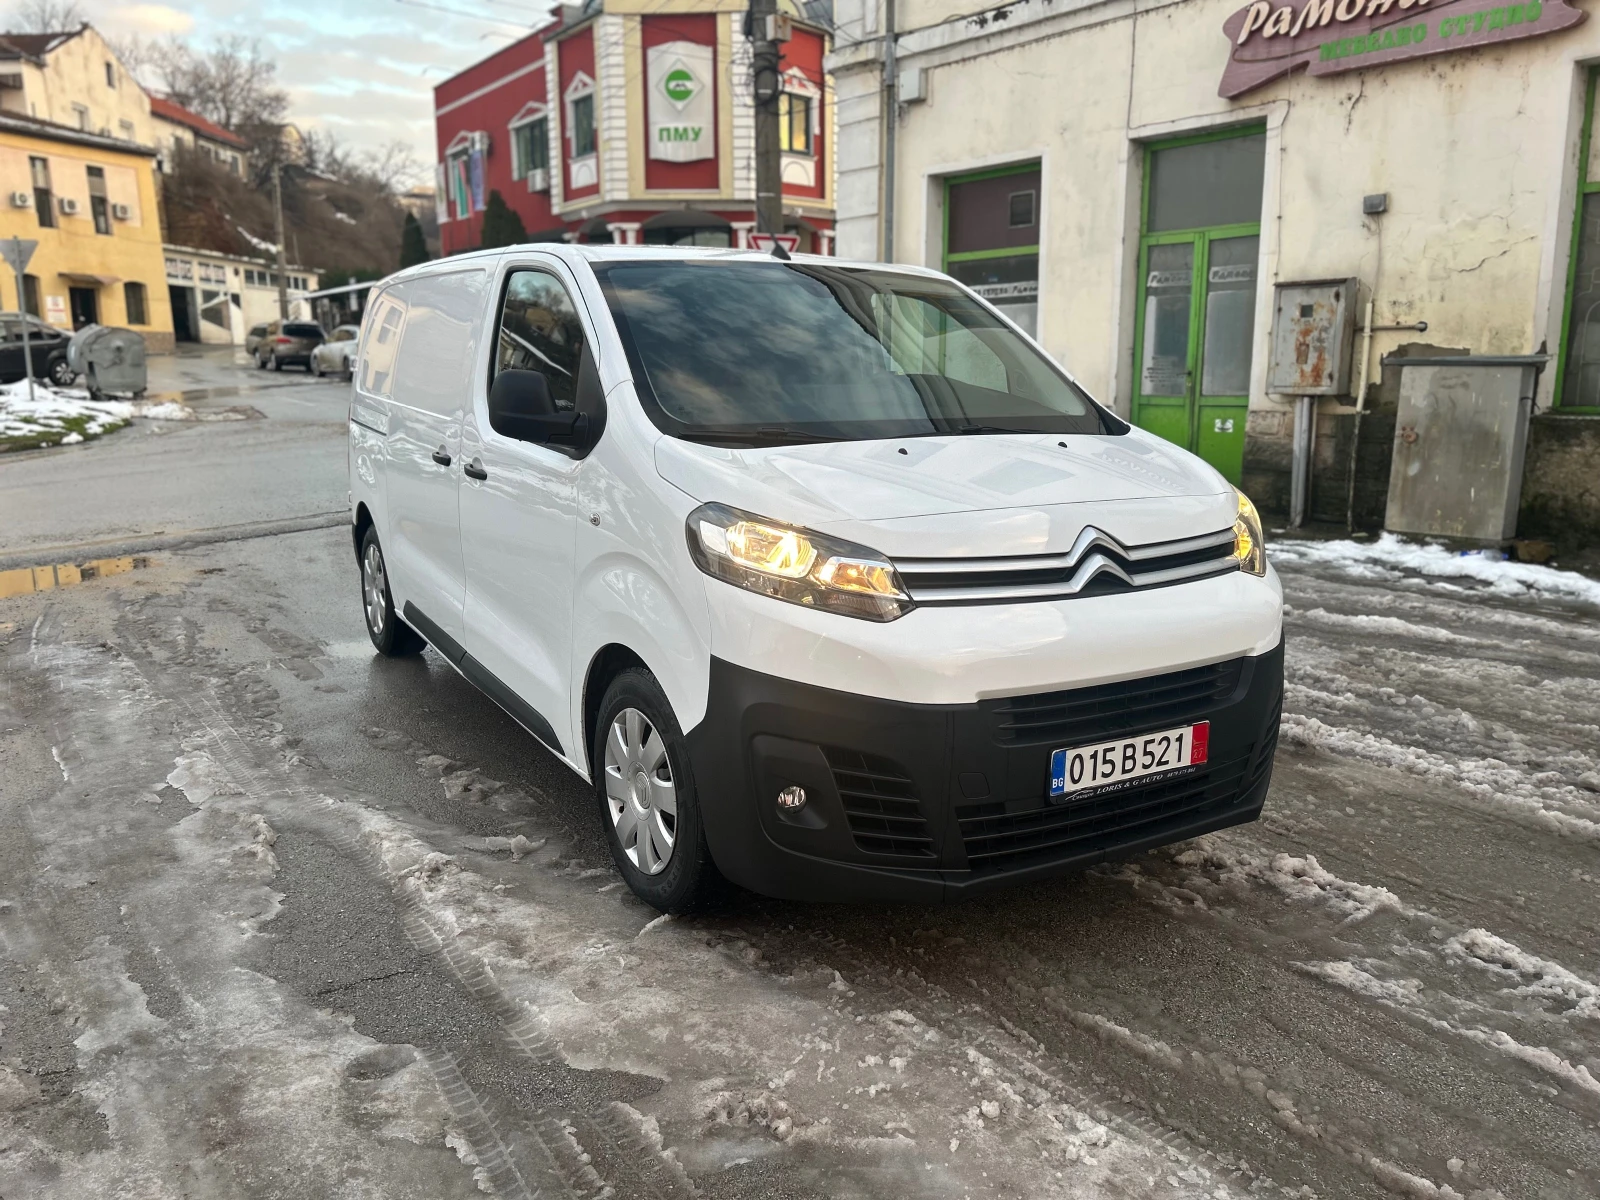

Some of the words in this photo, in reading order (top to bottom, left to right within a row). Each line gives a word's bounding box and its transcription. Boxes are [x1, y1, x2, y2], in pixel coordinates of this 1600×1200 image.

[1236, 0, 1430, 45] РаМон
[1438, 0, 1543, 38] СТУДИО
[658, 126, 702, 142] ПМУ
[1052, 777, 1064, 788] BG
[1070, 733, 1184, 784] 015B521
[1096, 783, 1123, 794] LORIS
[1140, 775, 1164, 784] AUTO
